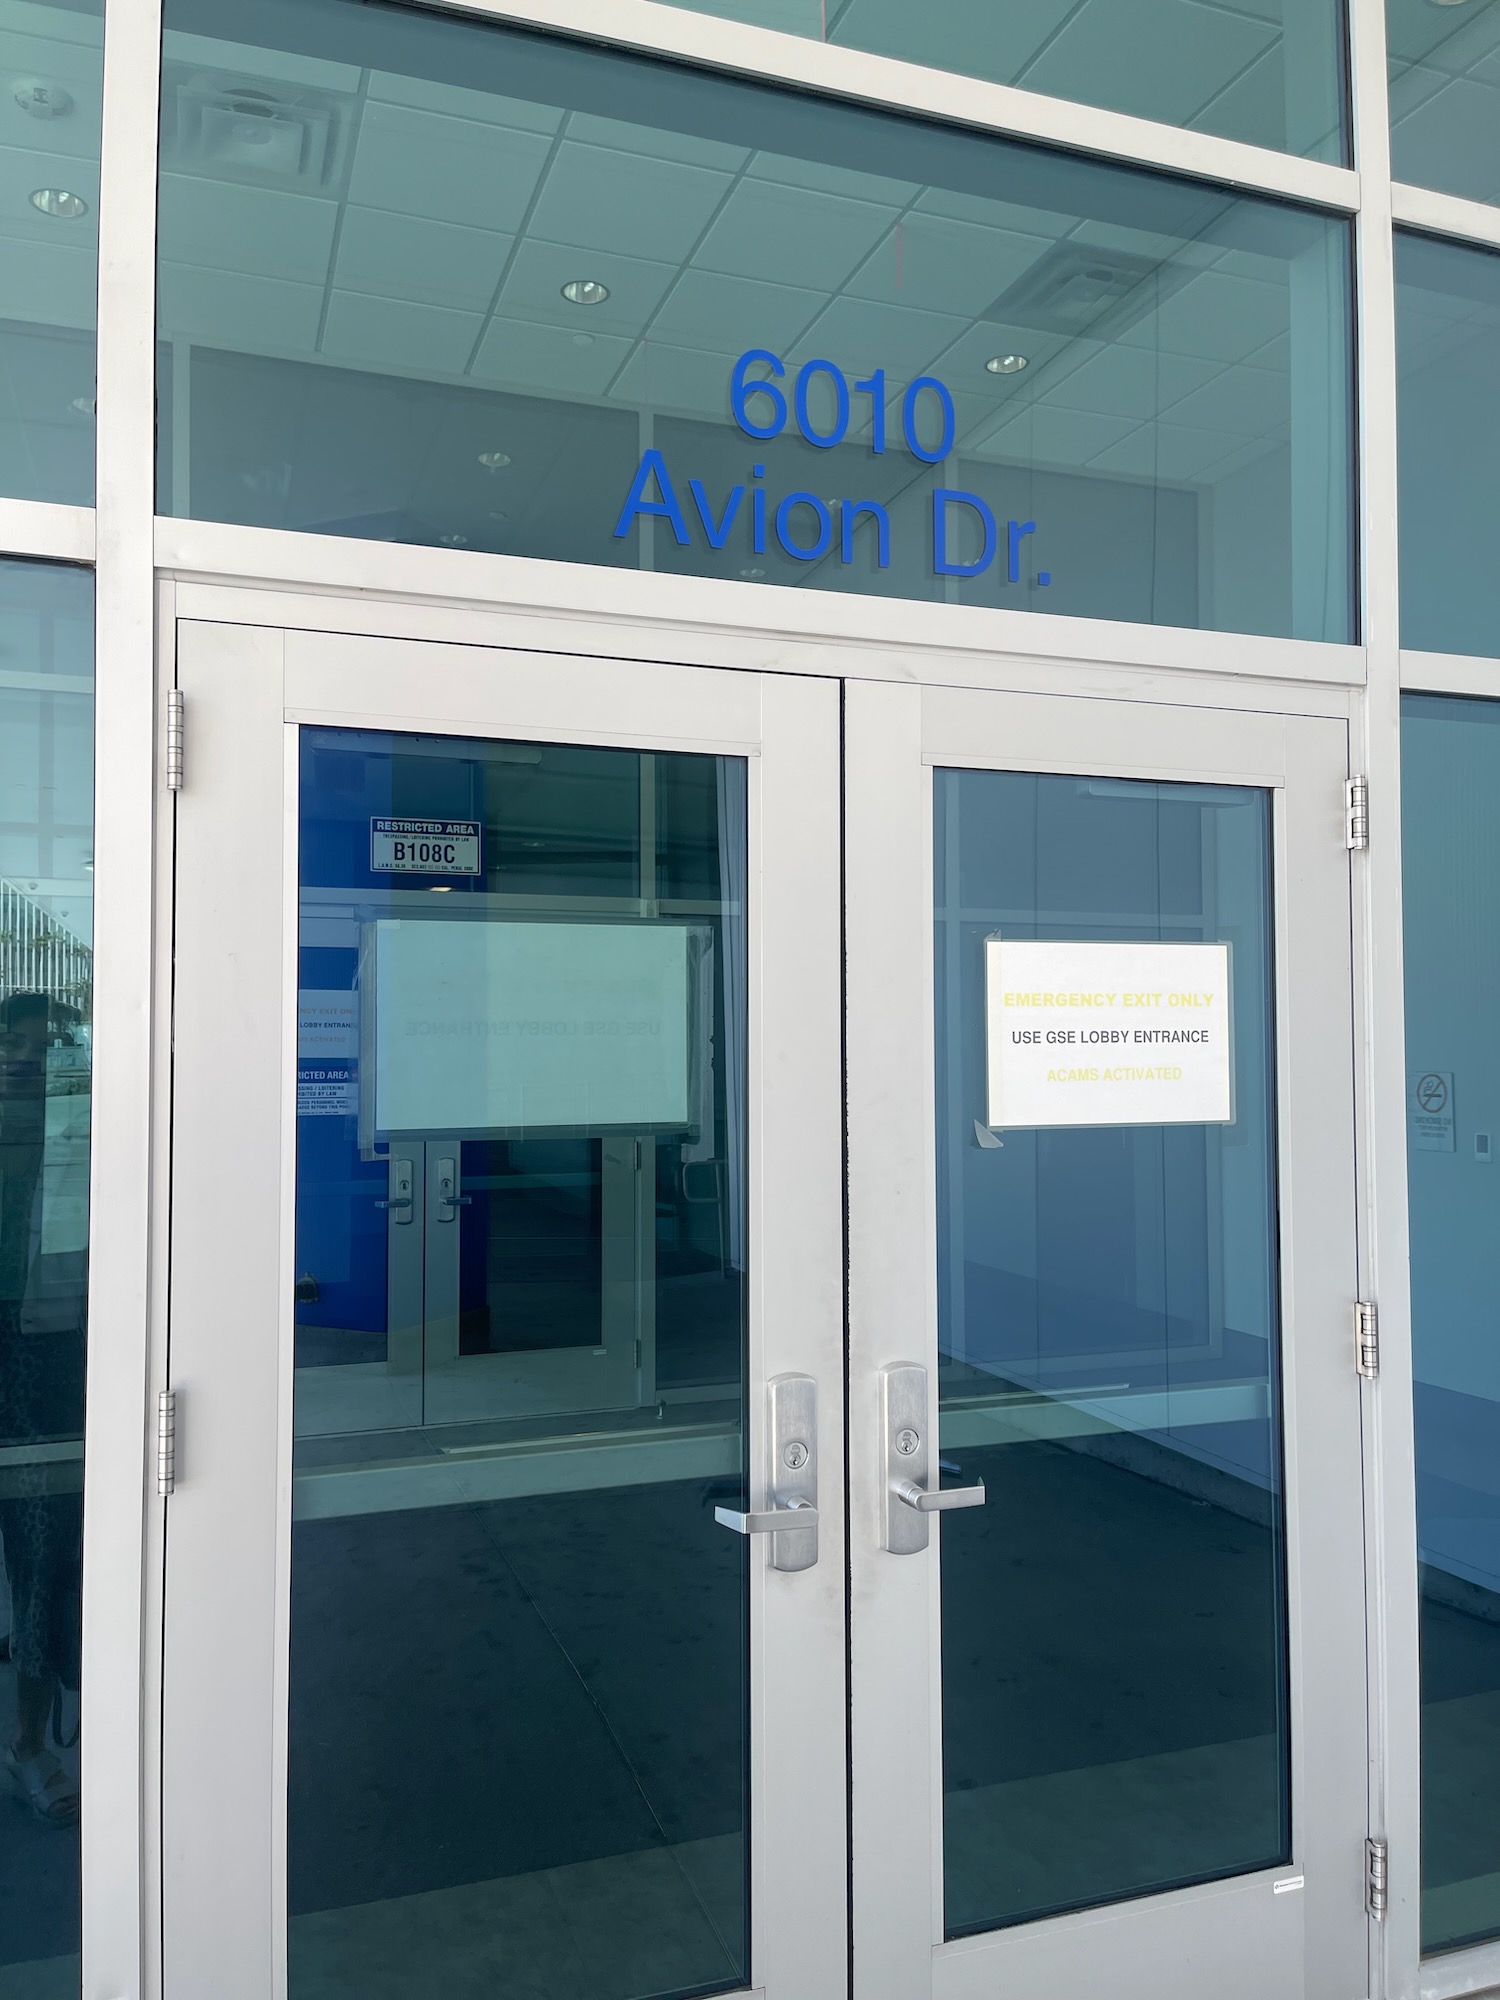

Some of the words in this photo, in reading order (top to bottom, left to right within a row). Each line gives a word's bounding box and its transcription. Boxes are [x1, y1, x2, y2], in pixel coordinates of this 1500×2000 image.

[731, 349, 956, 464] 6010
[613, 448, 891, 569] Avion
[933, 488, 1051, 587] Dr.
[377, 821, 442, 833] RESTRICTED
[446, 824, 475, 834] AREA
[394, 842, 455, 863] B108C
[1004, 992, 1117, 1008] EMERGENCY
[1123, 993, 1162, 1007] EXIT
[1168, 993, 1214, 1007] ONLY
[1012, 1031, 1041, 1044] USE
[1046, 1031, 1076, 1044] GSE
[1080, 1031, 1129, 1043] LOBBY
[1134, 1030, 1209, 1043] ENTRANCE
[298, 1070, 325, 1080] RICTED
[327, 1070, 349, 1080] AREA
[1047, 1068, 1099, 1082] ACAMS
[1104, 1067, 1182, 1081] ACTIVATED
